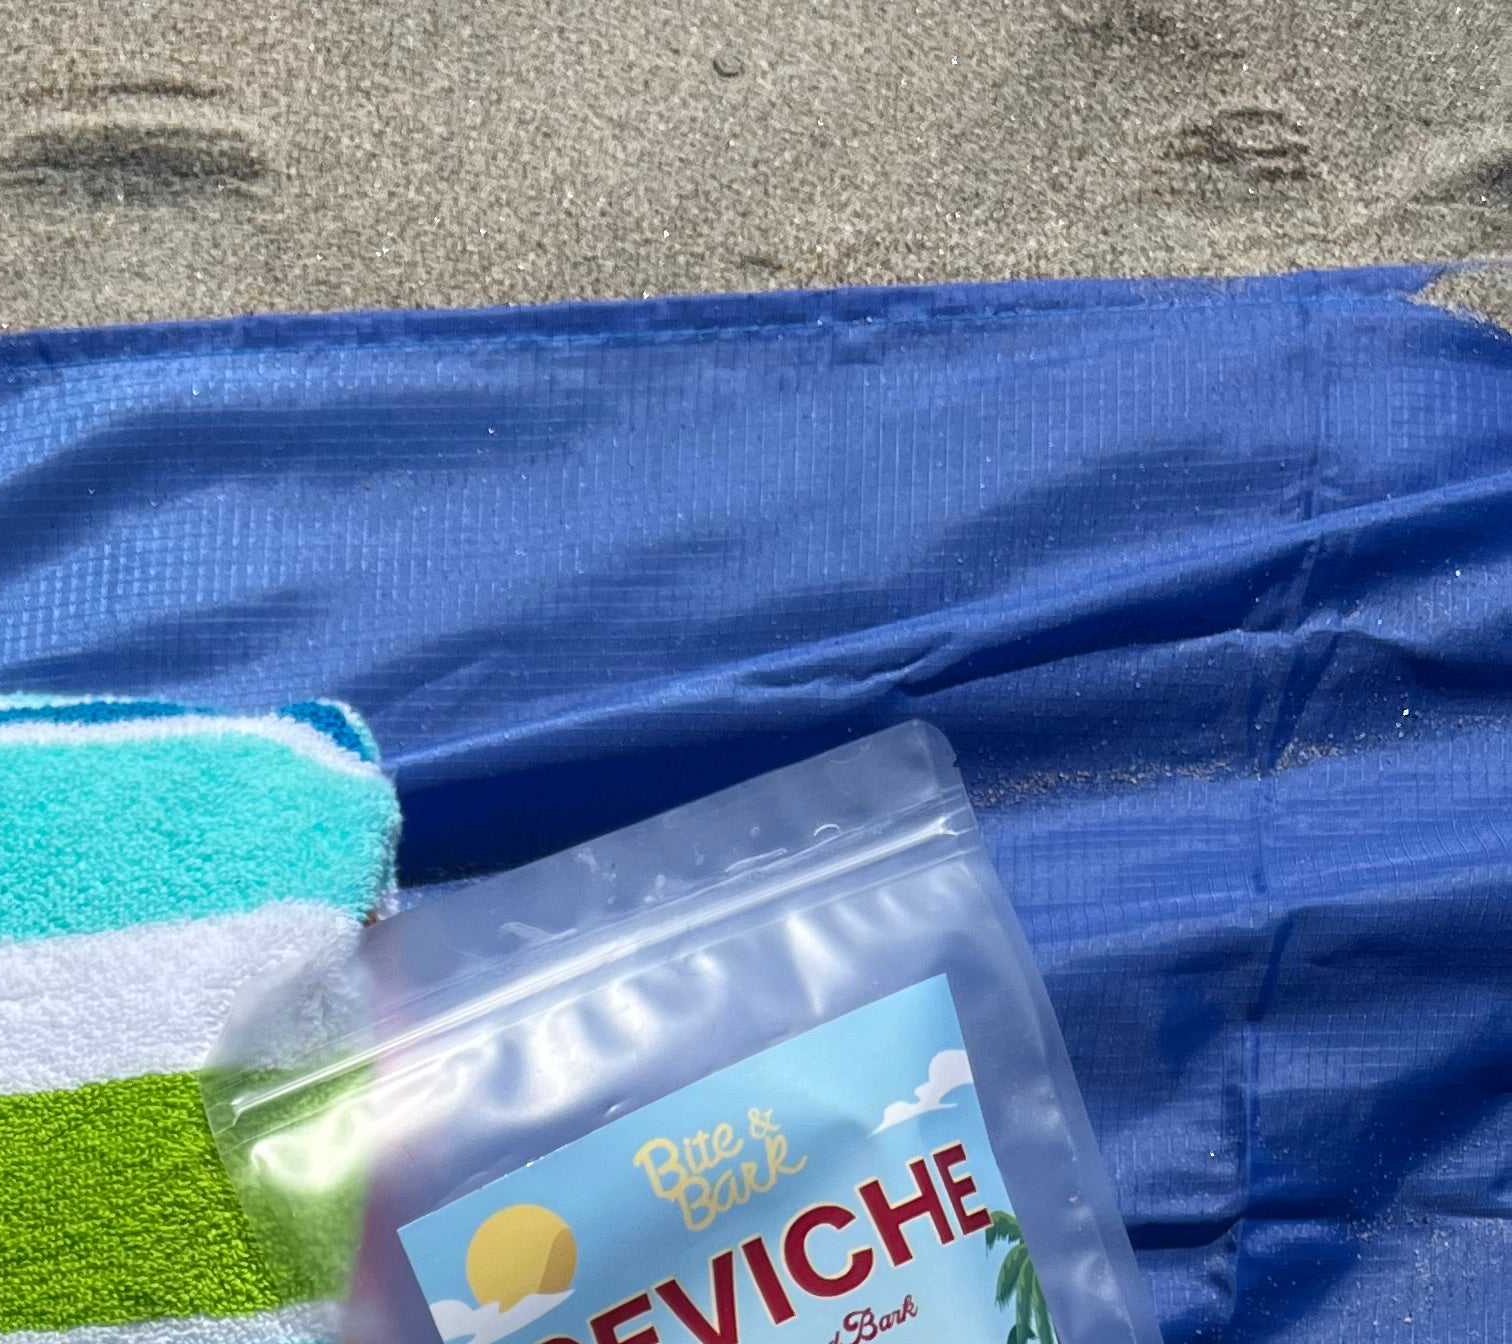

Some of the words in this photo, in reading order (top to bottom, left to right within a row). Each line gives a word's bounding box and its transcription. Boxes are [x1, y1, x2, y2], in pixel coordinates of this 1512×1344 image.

[633, 1121, 744, 1200] Bite
[747, 1107, 781, 1139] &
[679, 1134, 808, 1231] Bark
